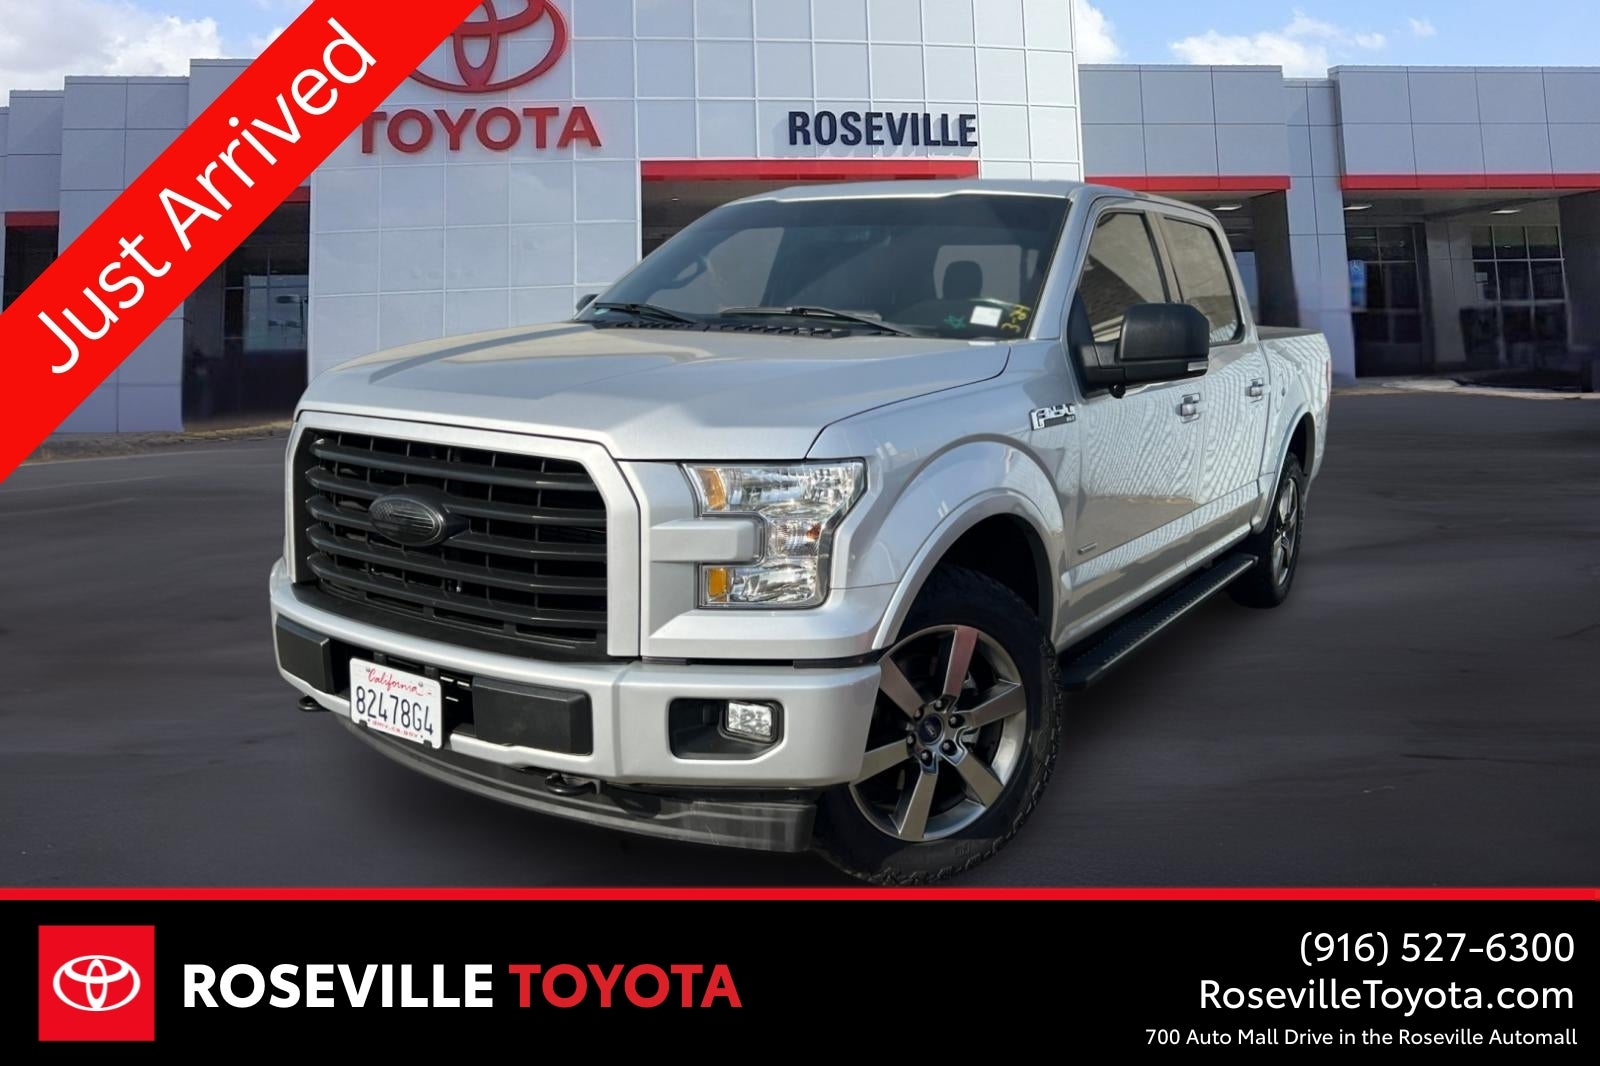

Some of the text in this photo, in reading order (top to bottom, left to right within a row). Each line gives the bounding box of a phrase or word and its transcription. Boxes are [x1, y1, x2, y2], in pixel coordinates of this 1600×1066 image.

[361, 105, 602, 154] TOYOTA
[788, 110, 978, 147] ROSEVILLE
[367, 667, 421, 693] California
[355, 685, 434, 735] 82478G4
